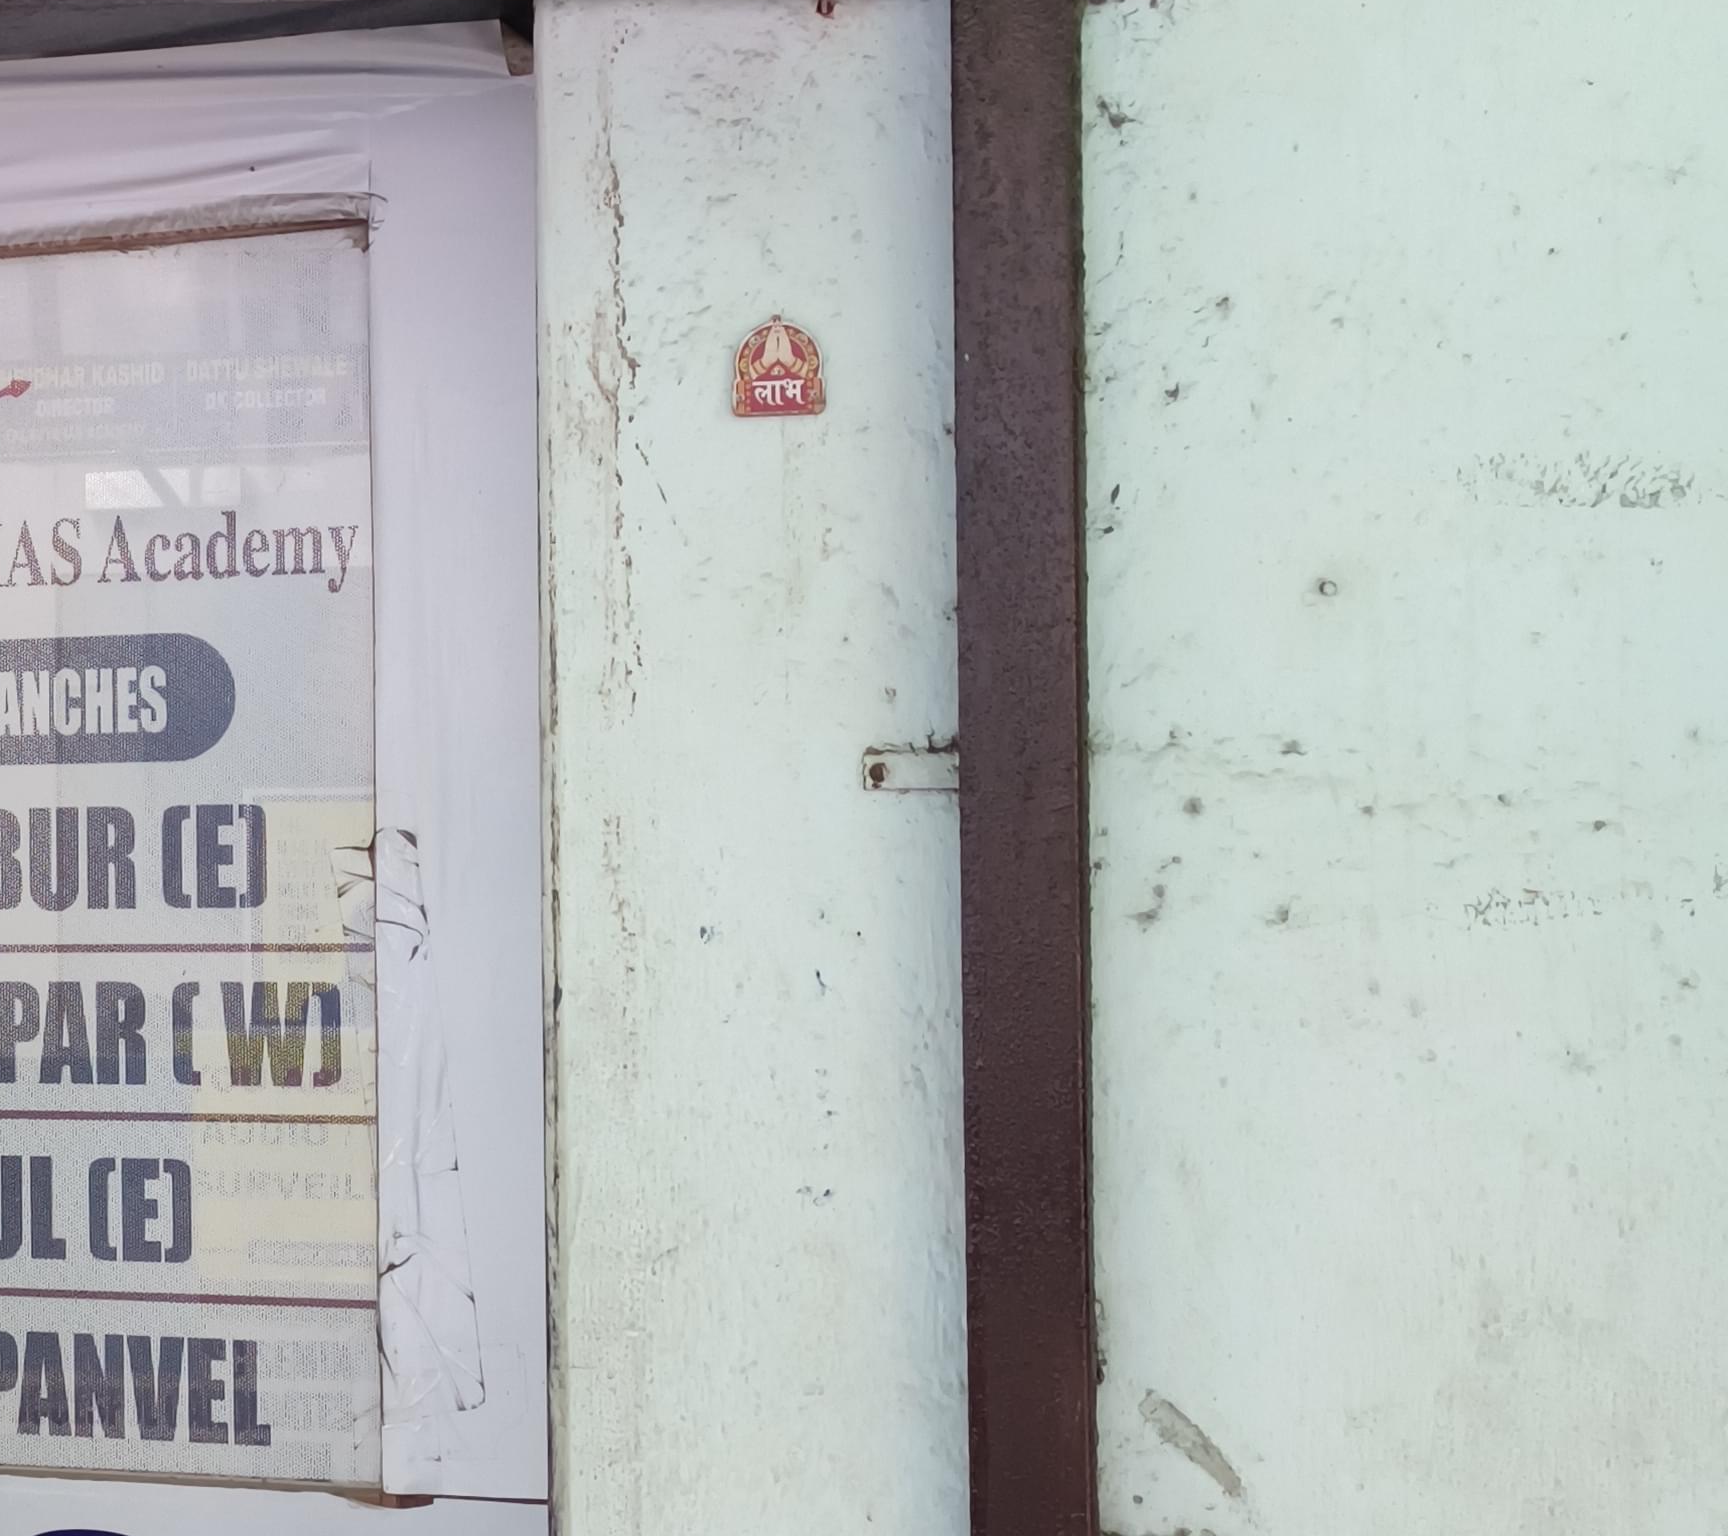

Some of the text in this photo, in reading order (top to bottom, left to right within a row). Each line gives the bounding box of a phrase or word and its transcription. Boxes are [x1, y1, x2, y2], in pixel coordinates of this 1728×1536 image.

[752, 378, 805, 406] लाभ
[97, 510, 359, 593] Academy
[162, 803, 268, 909] (E)
[88, 1156, 193, 1264] (E)
